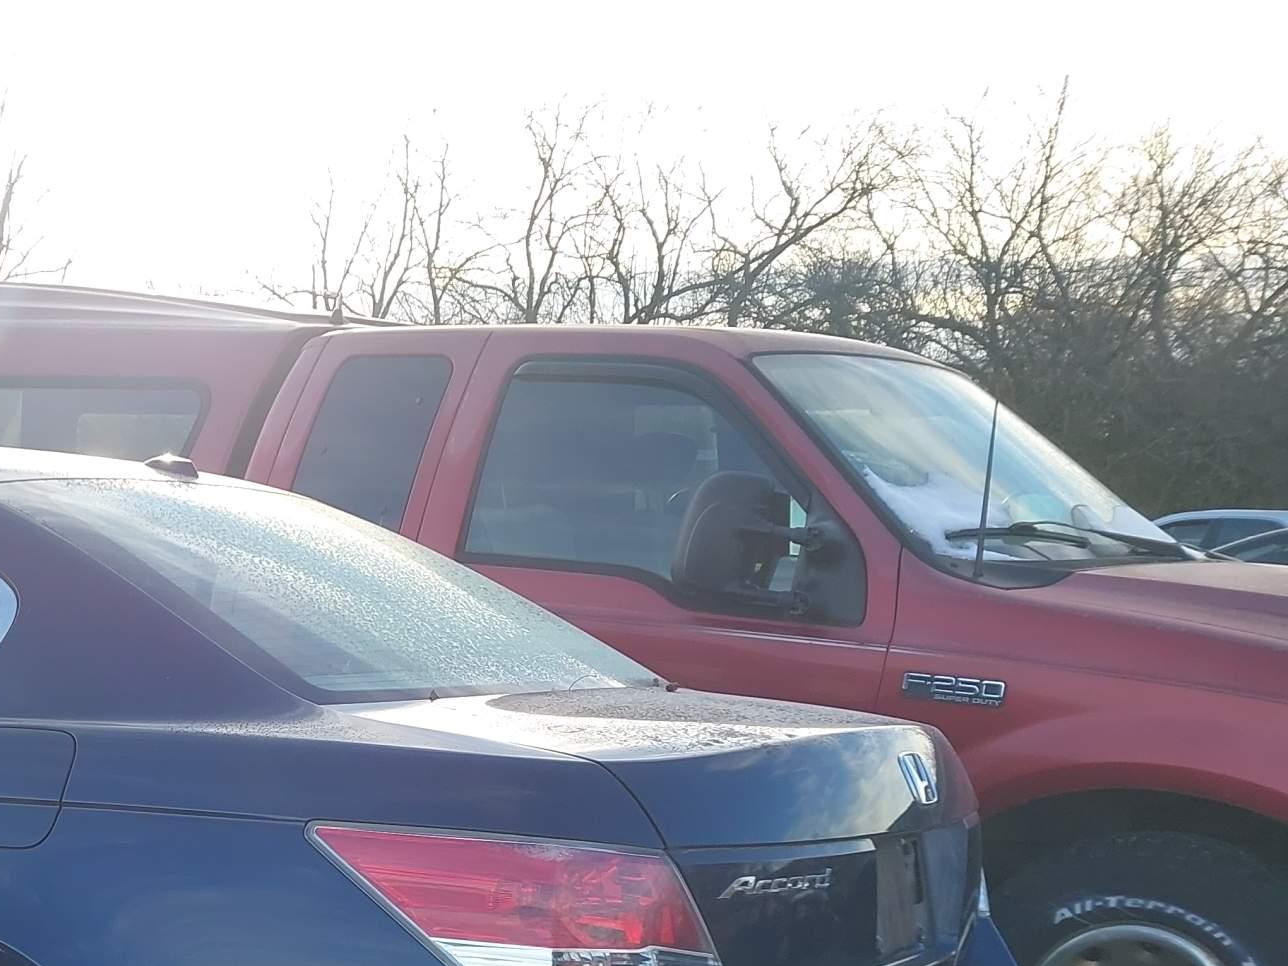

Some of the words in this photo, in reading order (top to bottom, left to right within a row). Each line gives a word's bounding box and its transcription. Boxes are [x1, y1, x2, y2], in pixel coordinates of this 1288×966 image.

[902, 672, 1005, 698] F-250
[934, 693, 969, 703] SUPER
[972, 697, 1002, 706] DUTY
[717, 867, 832, 900] Accord
[1053, 895, 1233, 947] All-Terrain
